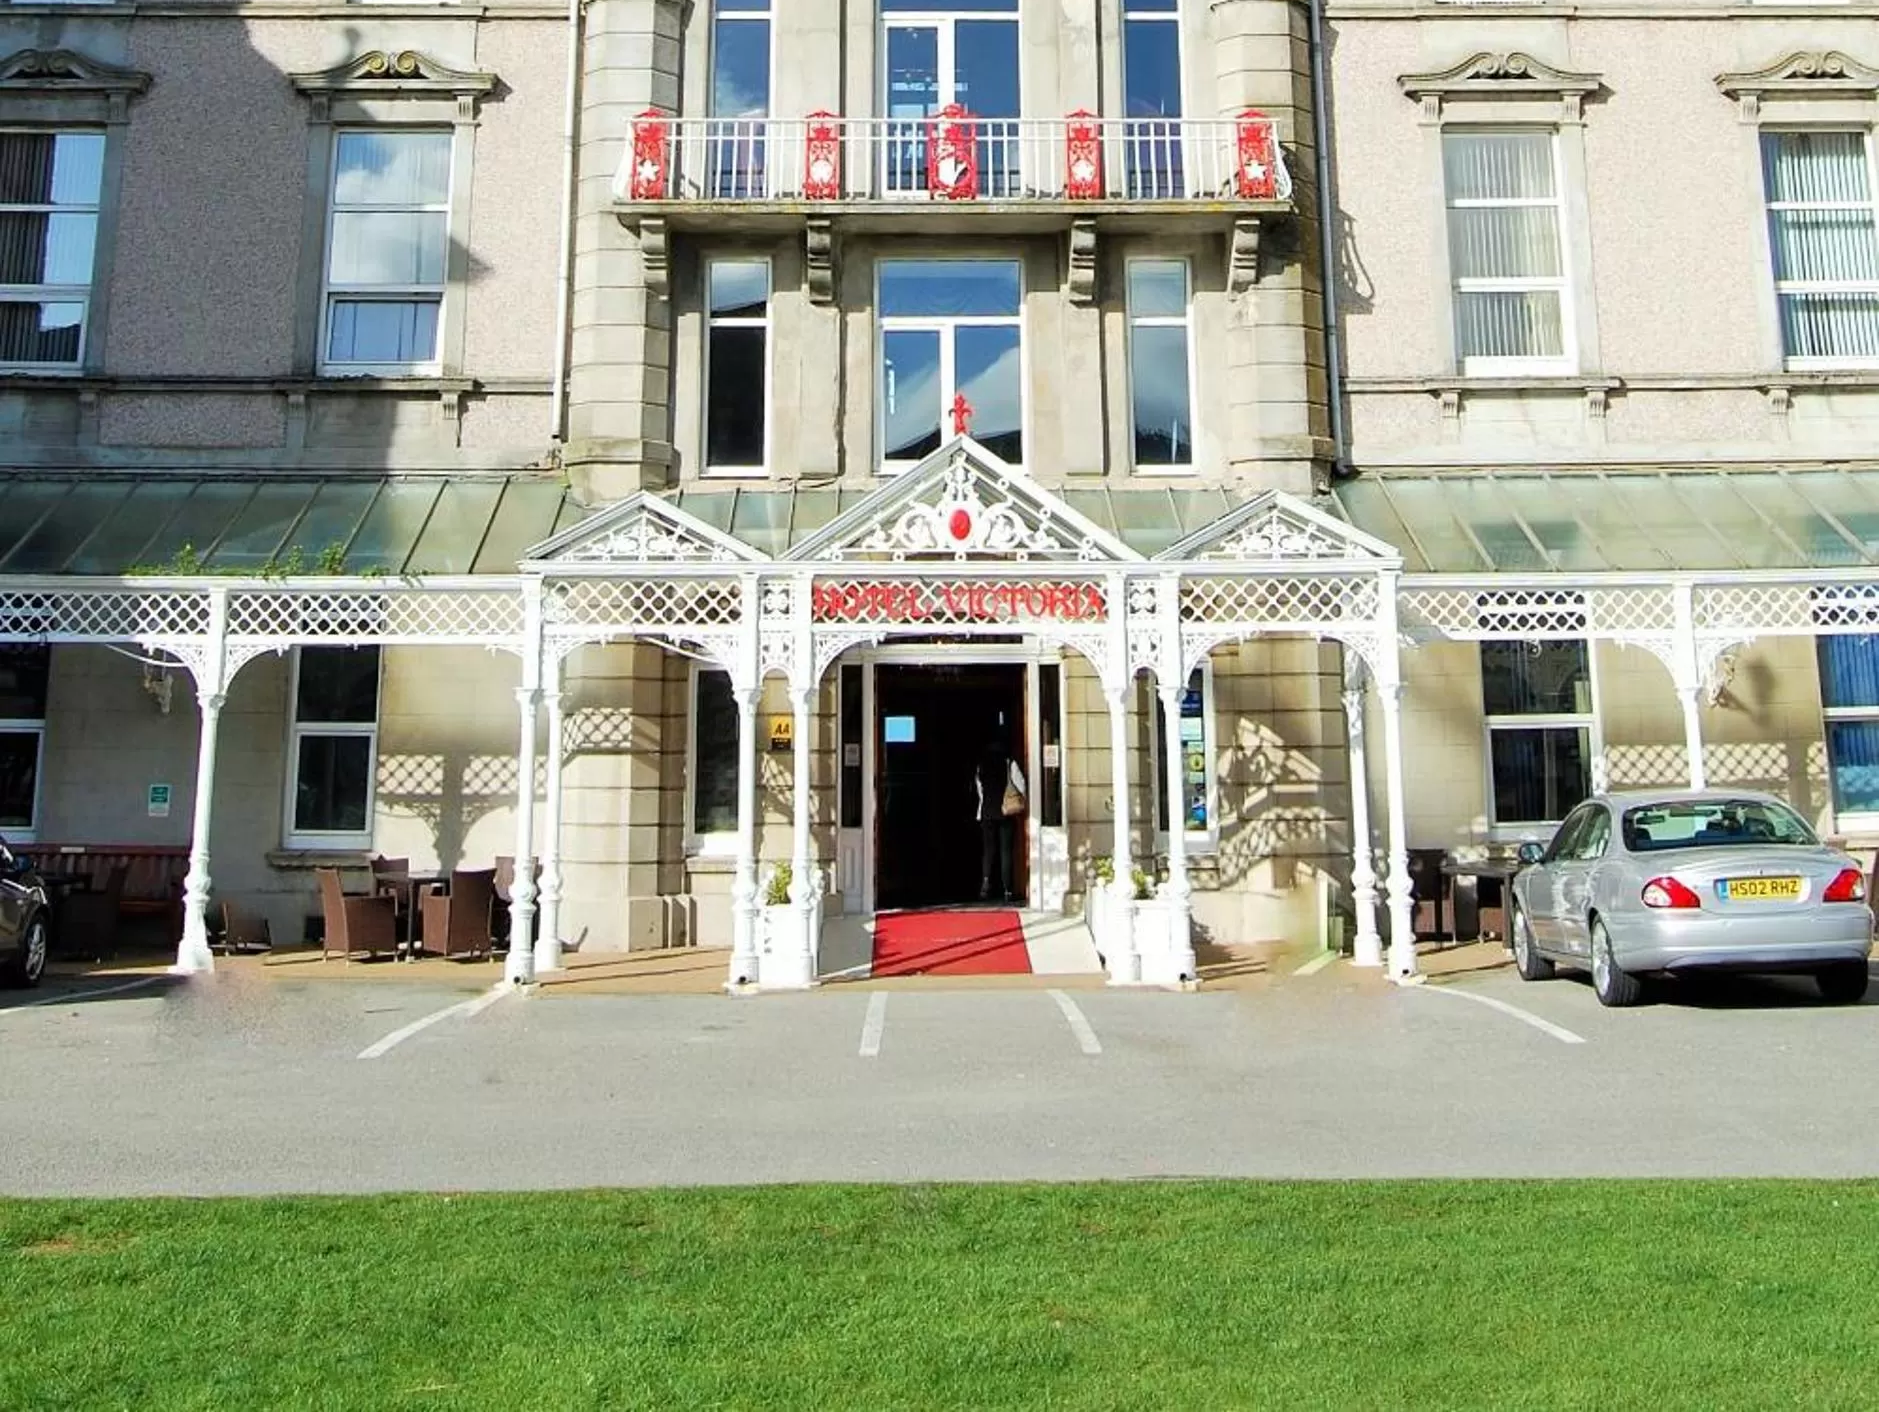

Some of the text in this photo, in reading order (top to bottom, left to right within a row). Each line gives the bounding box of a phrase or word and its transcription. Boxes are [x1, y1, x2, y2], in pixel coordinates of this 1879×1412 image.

[813, 585, 1107, 621] HOTEL VICTORIA
[775, 722, 790, 735] AA
[1730, 879, 1800, 896] HS02 RHZ
